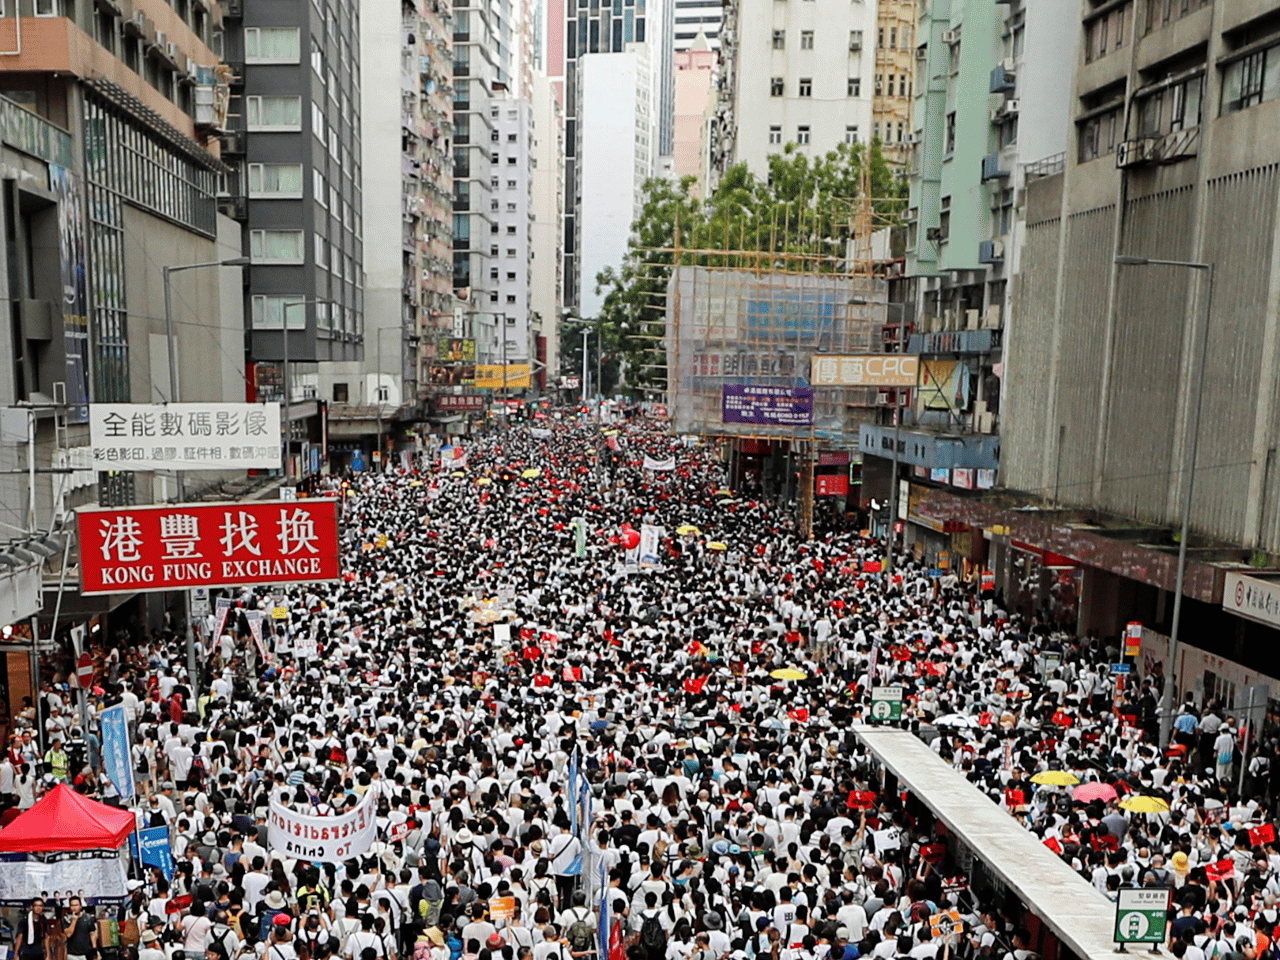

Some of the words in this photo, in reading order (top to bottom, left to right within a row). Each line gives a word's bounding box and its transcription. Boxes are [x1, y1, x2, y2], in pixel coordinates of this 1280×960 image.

[866, 357, 916, 376] CAC
[103, 411, 268, 437] 全能數碼影像
[101, 565, 154, 585] KONG
[163, 562, 212, 581] FUNG
[221, 557, 321, 578] EXCHANGE
